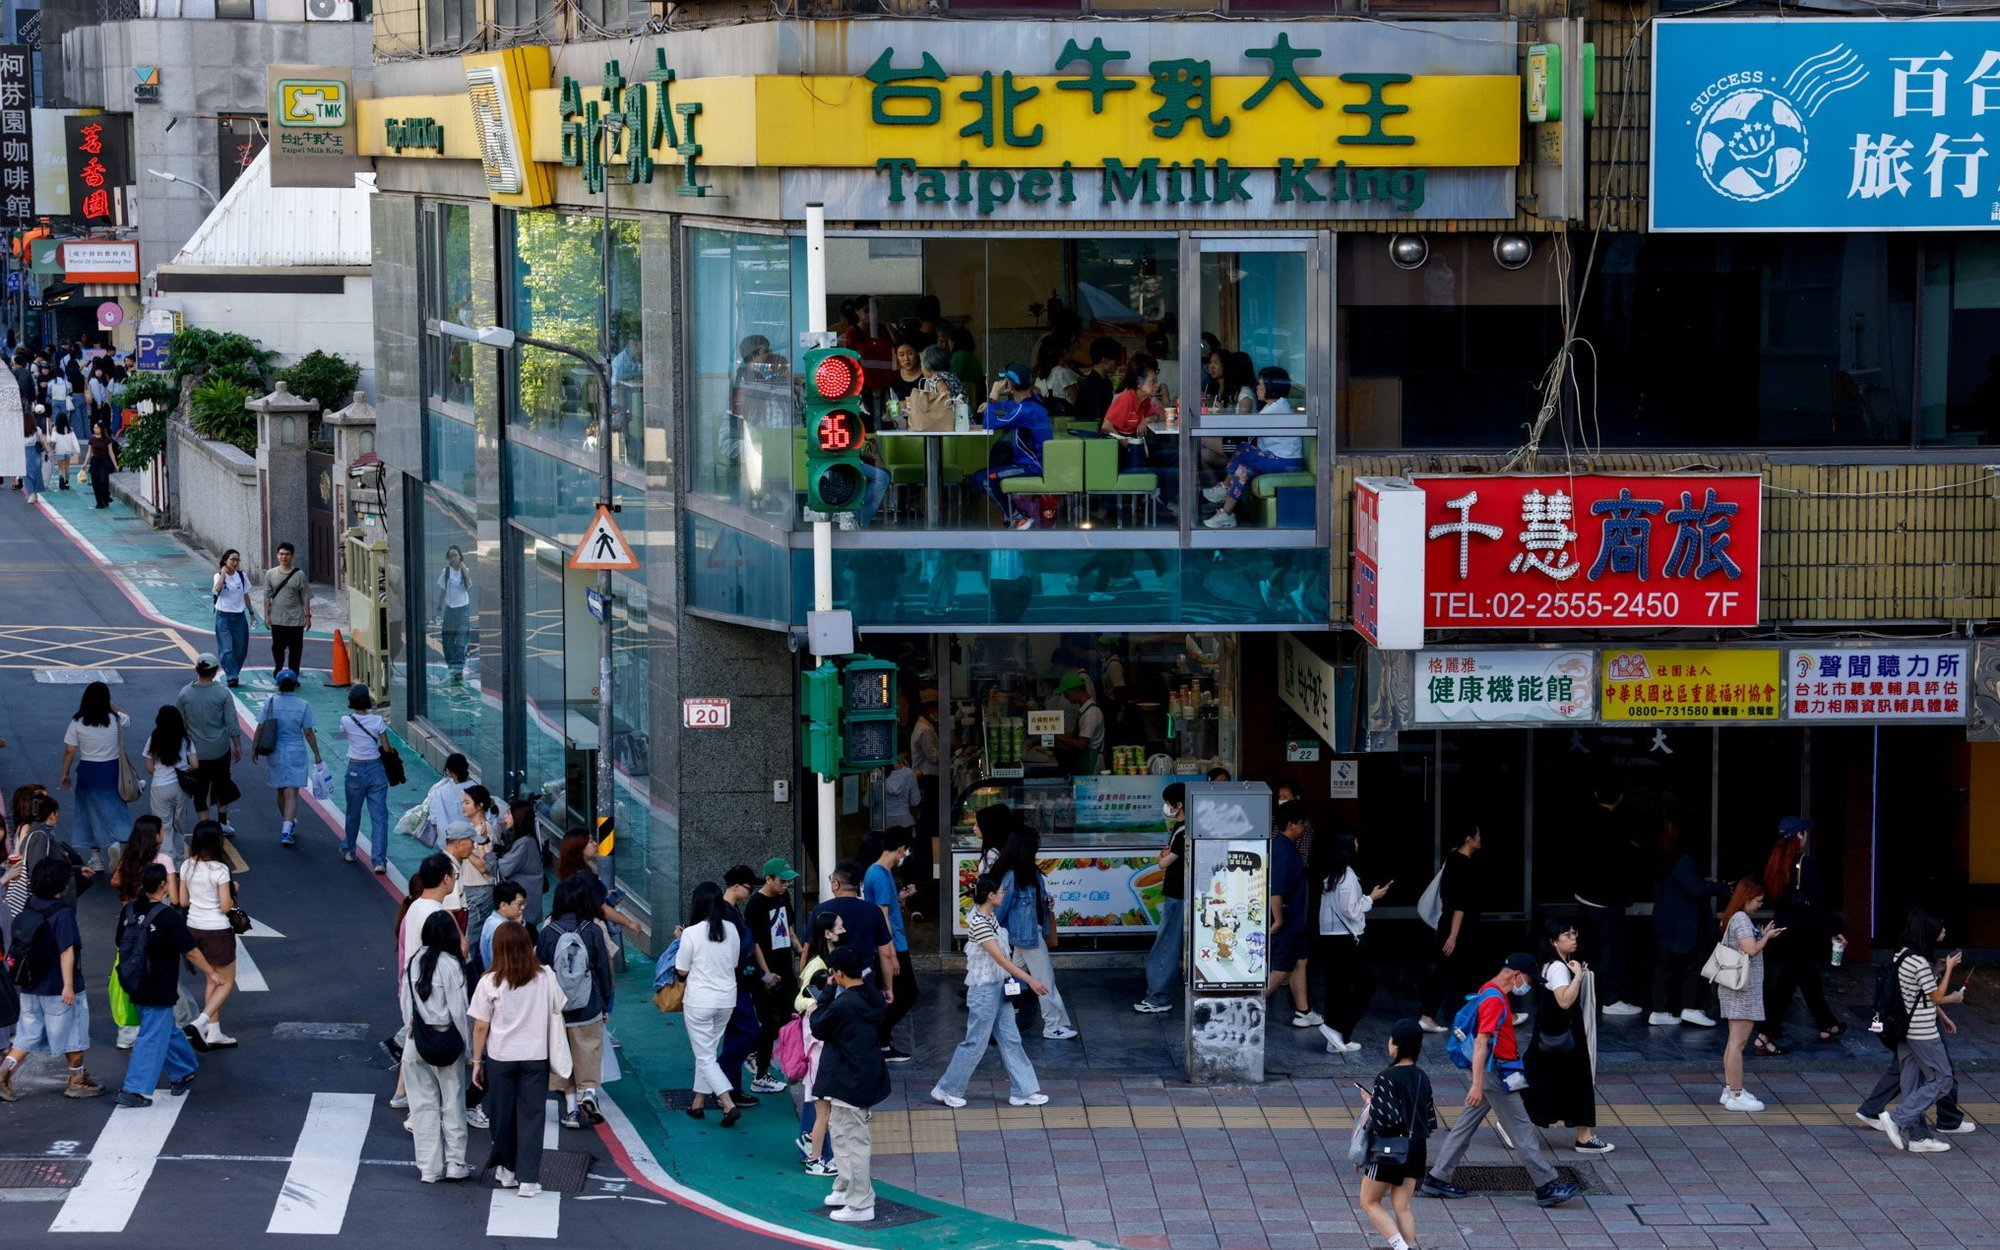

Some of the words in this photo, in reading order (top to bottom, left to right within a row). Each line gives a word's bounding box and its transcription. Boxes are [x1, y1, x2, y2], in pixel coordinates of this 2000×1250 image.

[865, 31, 1416, 148] 台北牛乳大王
[1690, 71, 1764, 115] SUCCESS
[316, 103, 343, 118] TMK
[0, 53, 31, 219] 柯芬園咖啡館
[281, 131, 344, 147] 台北牛乳大王
[281, 147, 305, 155] Taipei
[325, 147, 344, 155] King
[1847, 132, 2000, 199] 旅行
[876, 157, 1078, 214] Taipei
[1103, 157, 1254, 204] Milk
[1278, 157, 1427, 212] King
[821, 414, 850, 449] 36
[1428, 488, 1741, 581] 千慧商旅
[1431, 592, 1679, 619] TEL:02-2555-2450
[1705, 592, 1739, 618] 7F
[1428, 657, 1476, 674] 格麗雅
[1656, 664, 1712, 677] 社團法人
[1819, 654, 1960, 678] 聲聞聽力所
[1428, 675, 1573, 704] 健康機能館
[1605, 684, 1777, 704] 中華民國社區重聽福利協會
[1795, 682, 1958, 696] 台北市聽覺輔具評估
[1559, 705, 1575, 716] 5F
[1628, 706, 1709, 717] 0800-731580
[1794, 699, 1959, 714] 聽力相關資訊輔具體驗
[696, 709, 719, 724] 20
[1299, 750, 1312, 760] 22
